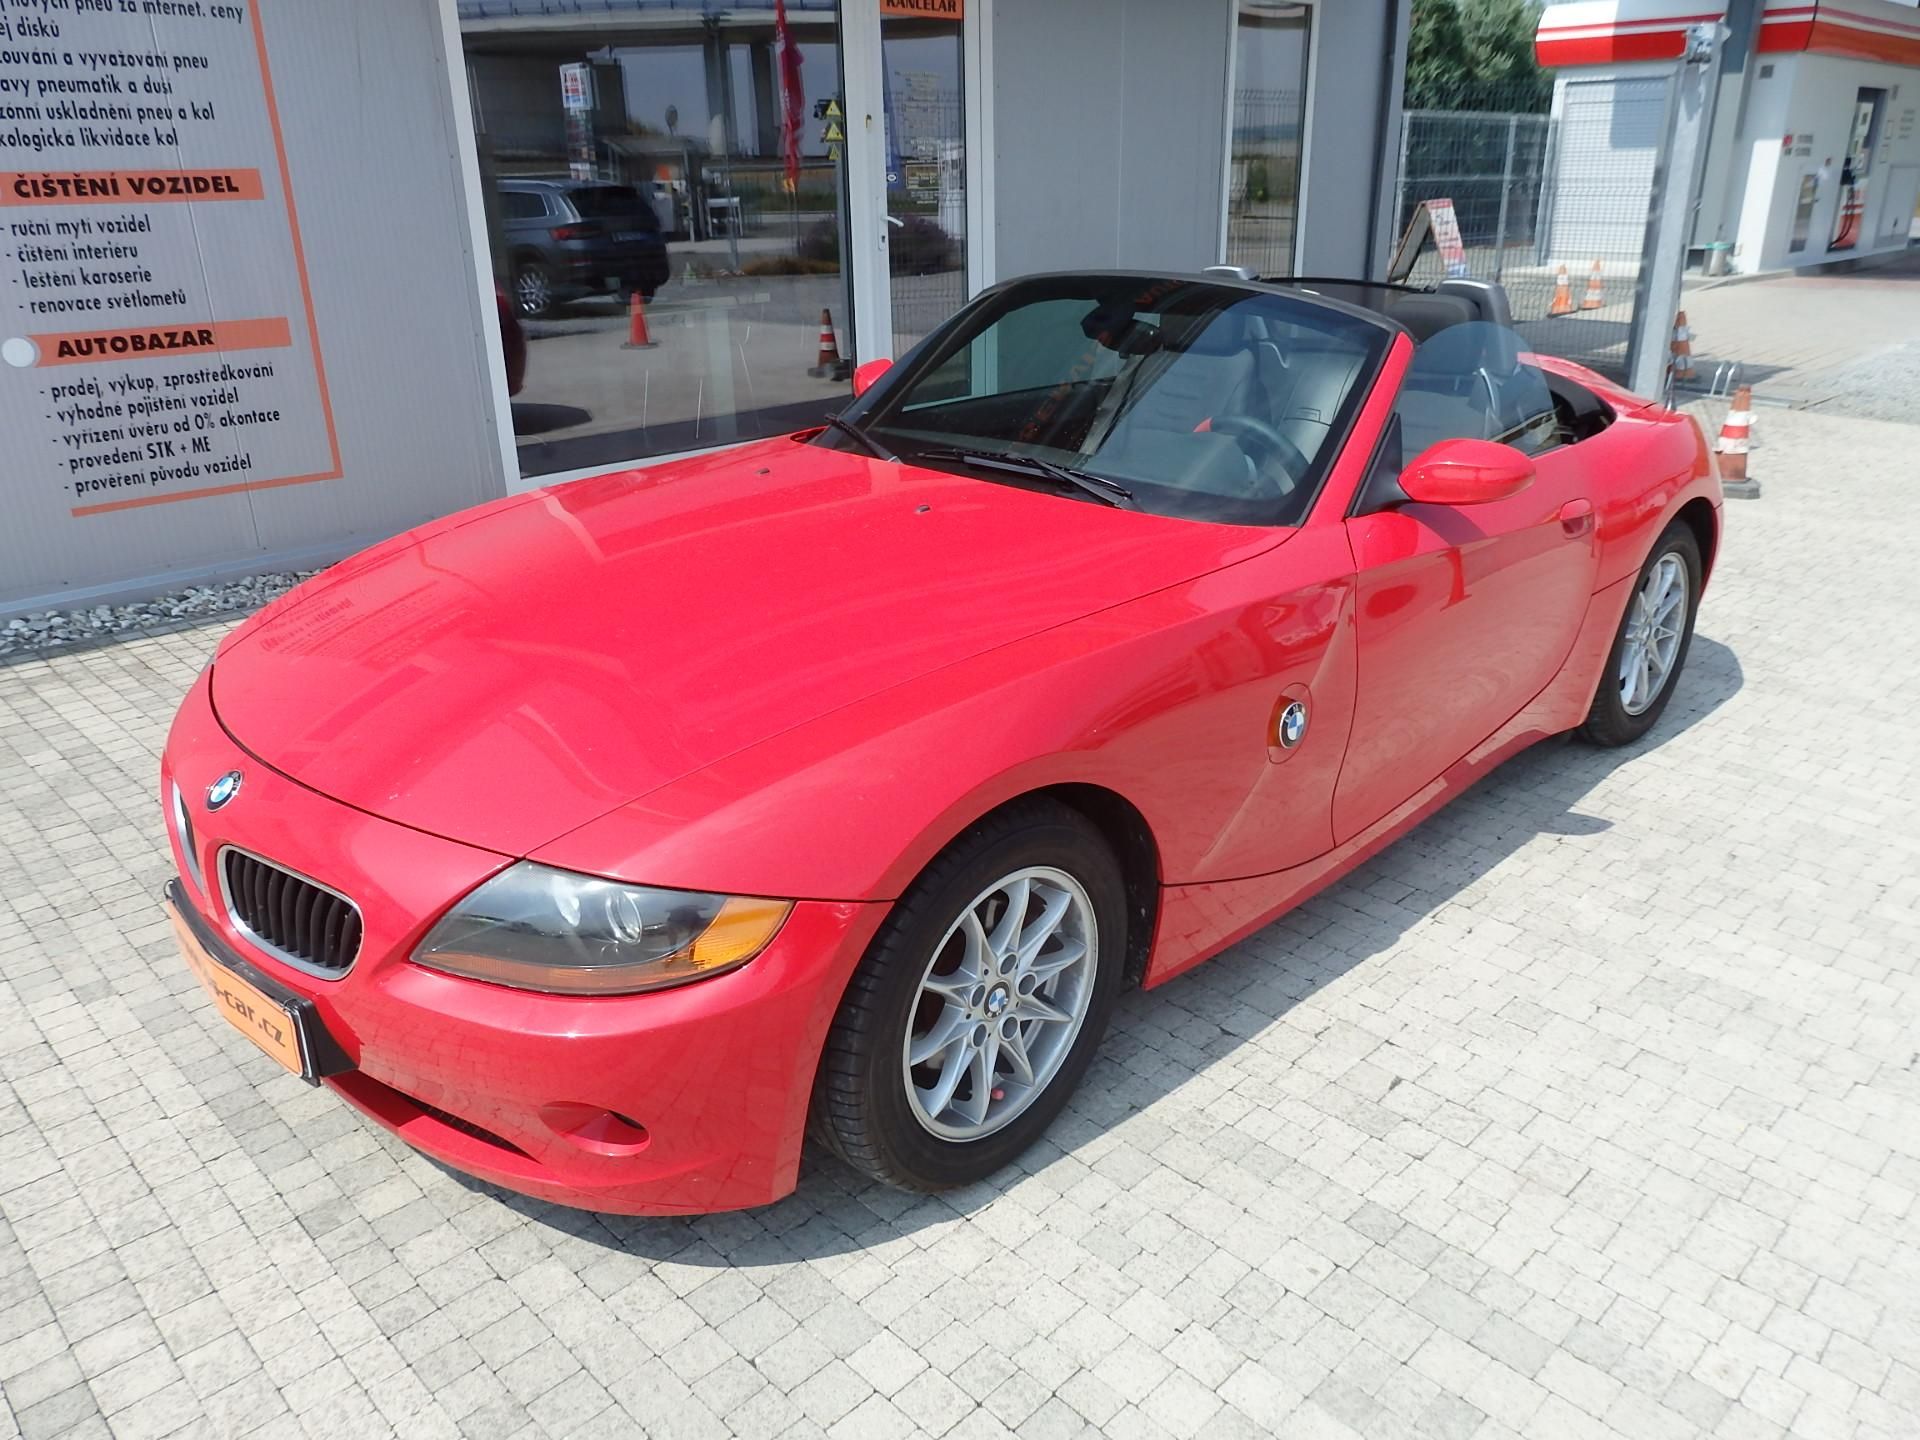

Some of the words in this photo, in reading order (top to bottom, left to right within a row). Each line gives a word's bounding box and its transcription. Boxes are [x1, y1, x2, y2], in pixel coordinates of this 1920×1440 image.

[76, 0, 114, 15] pneu
[120, 0, 137, 13] za
[210, 4, 244, 24] ceny
[17, 16, 60, 38] disků
[64, 53, 73, 65] a
[79, 50, 169, 71] vyvažování
[174, 55, 209, 74] pneu
[37, 75, 122, 98] pneumatik
[128, 82, 138, 94] a
[48, 100, 133, 121] uskladnění
[137, 106, 173, 125] pneu
[178, 108, 188, 121] a
[191, 101, 216, 121] kol
[79, 127, 151, 147] likvidace
[154, 127, 179, 147] kol
[14, 173, 120, 198] ČIŠTĚNÍ
[127, 175, 240, 195] VOZIDEL
[11, 217, 51, 237] ruční
[97, 213, 152, 234] vozidel
[18, 243, 68, 263] čištění
[72, 241, 139, 261] interiéru
[22, 268, 77, 289] leštění
[80, 265, 152, 286] karoserie
[30, 298, 101, 315] renovace
[107, 287, 187, 310] světlometů
[57, 329, 215, 358] AUTOBAZAR
[51, 377, 104, 402] prodej,
[108, 373, 159, 396] výkup,
[163, 362, 274, 389] zprostředkování
[56, 401, 123, 427] výhodné
[127, 395, 187, 419] pojištění
[190, 386, 240, 407] vozidel
[63, 426, 125, 450] vyřízení
[129, 423, 169, 440] úvěru
[173, 415, 191, 434] od
[194, 412, 215, 431] 0%
[219, 408, 281, 428] akontace
[69, 447, 144, 474] provedení
[147, 440, 176, 461] STK
[191, 435, 212, 455] ME
[75, 470, 146, 497] prověření
[150, 461, 200, 486] původu
[204, 452, 252, 475] vozidel
